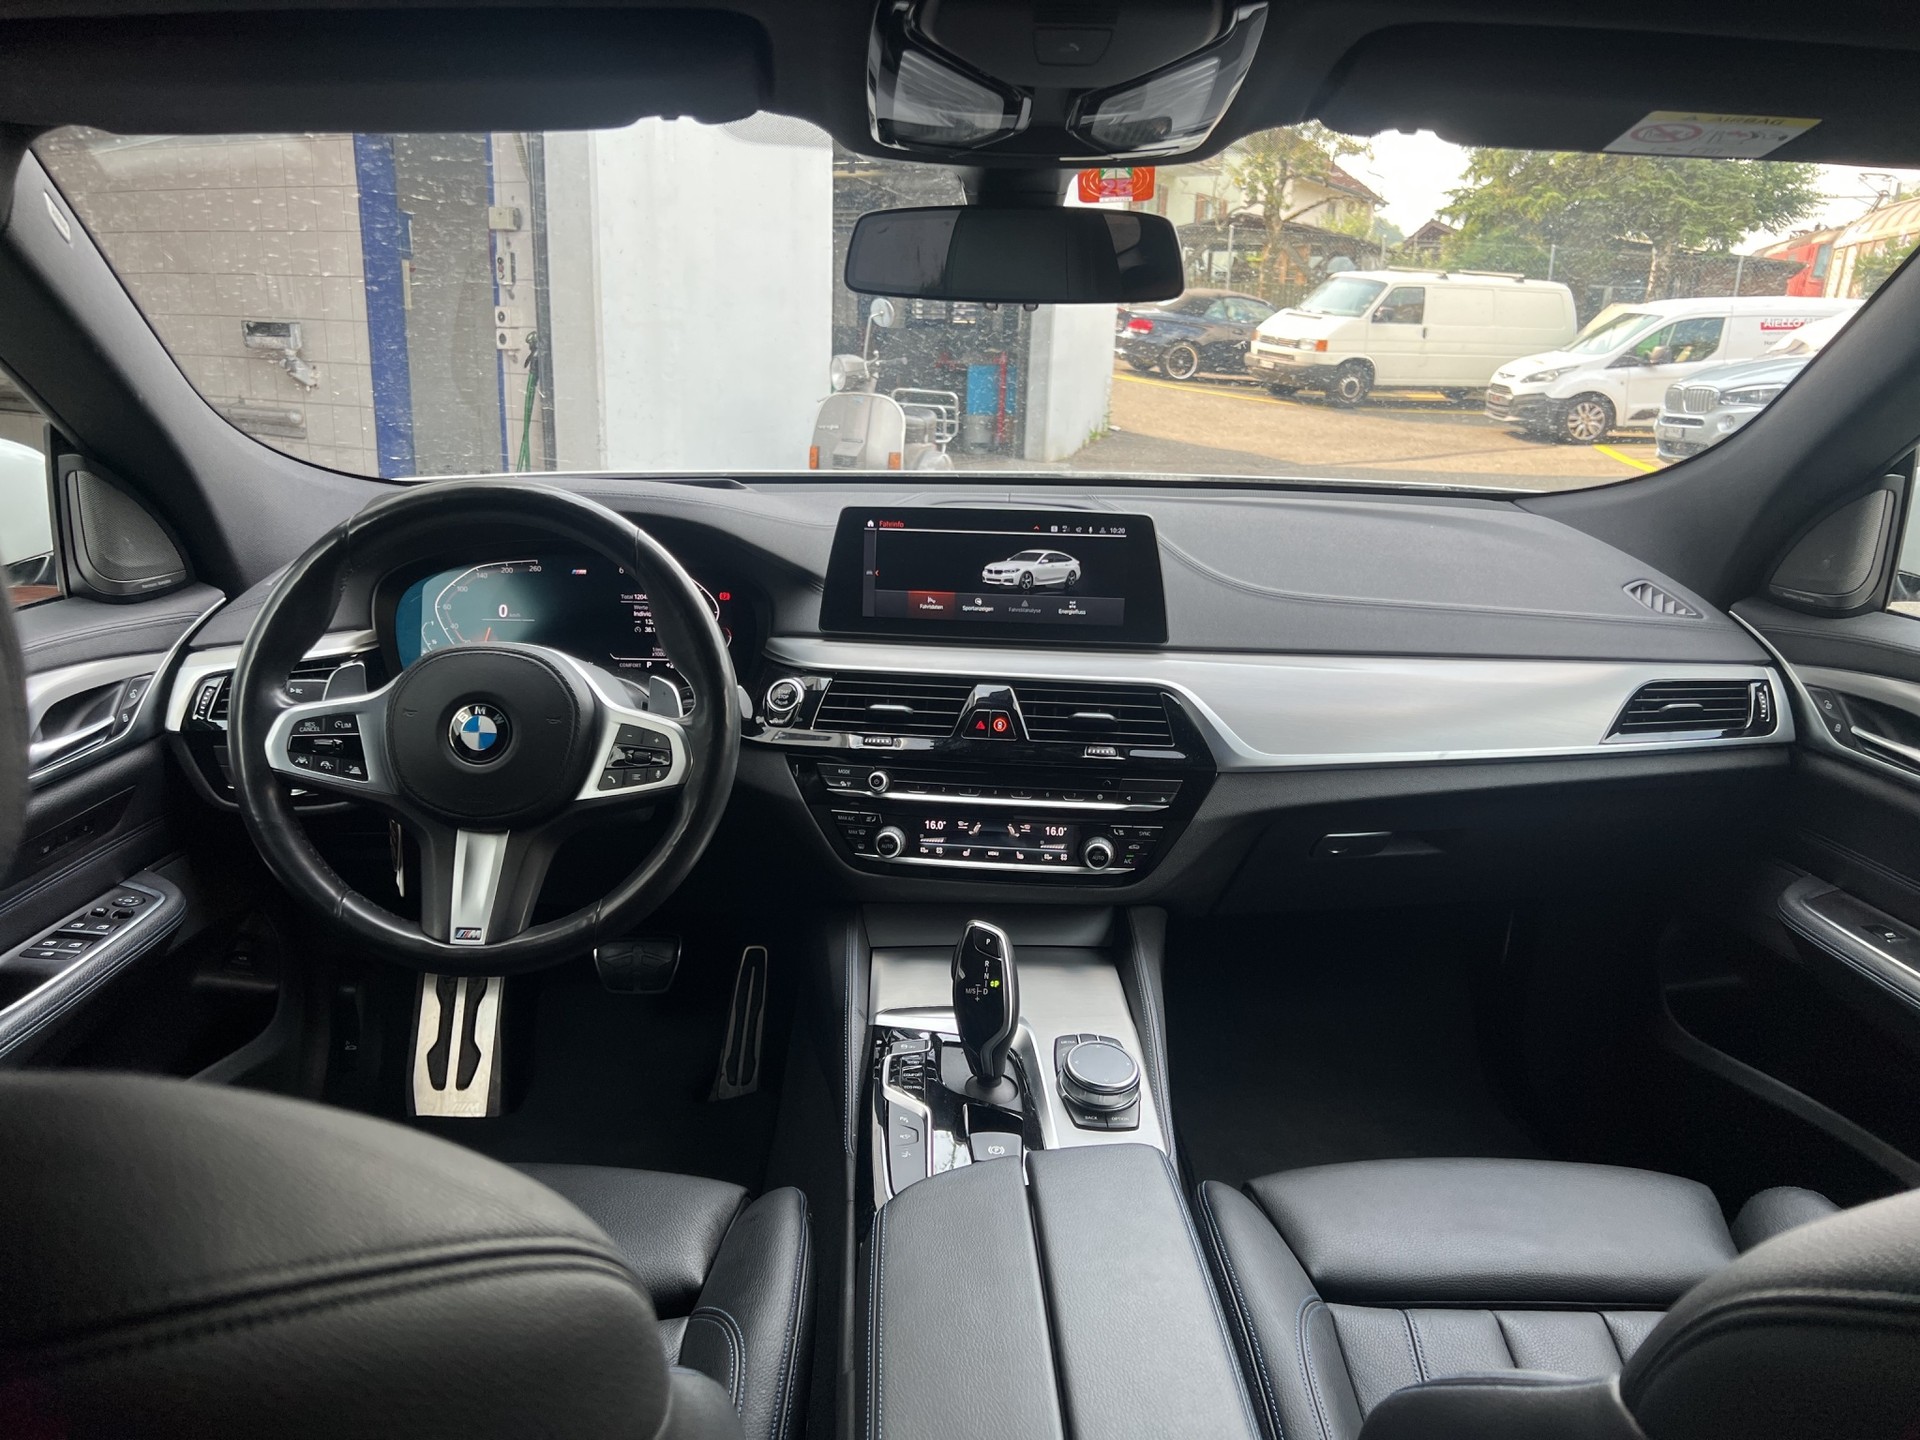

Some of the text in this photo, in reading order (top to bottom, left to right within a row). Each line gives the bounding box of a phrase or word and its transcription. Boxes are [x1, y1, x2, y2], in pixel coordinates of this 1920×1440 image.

[1714, 116, 1784, 126] AIRBAG
[499, 604, 508, 617] 0
[456, 706, 504, 725] BMW
